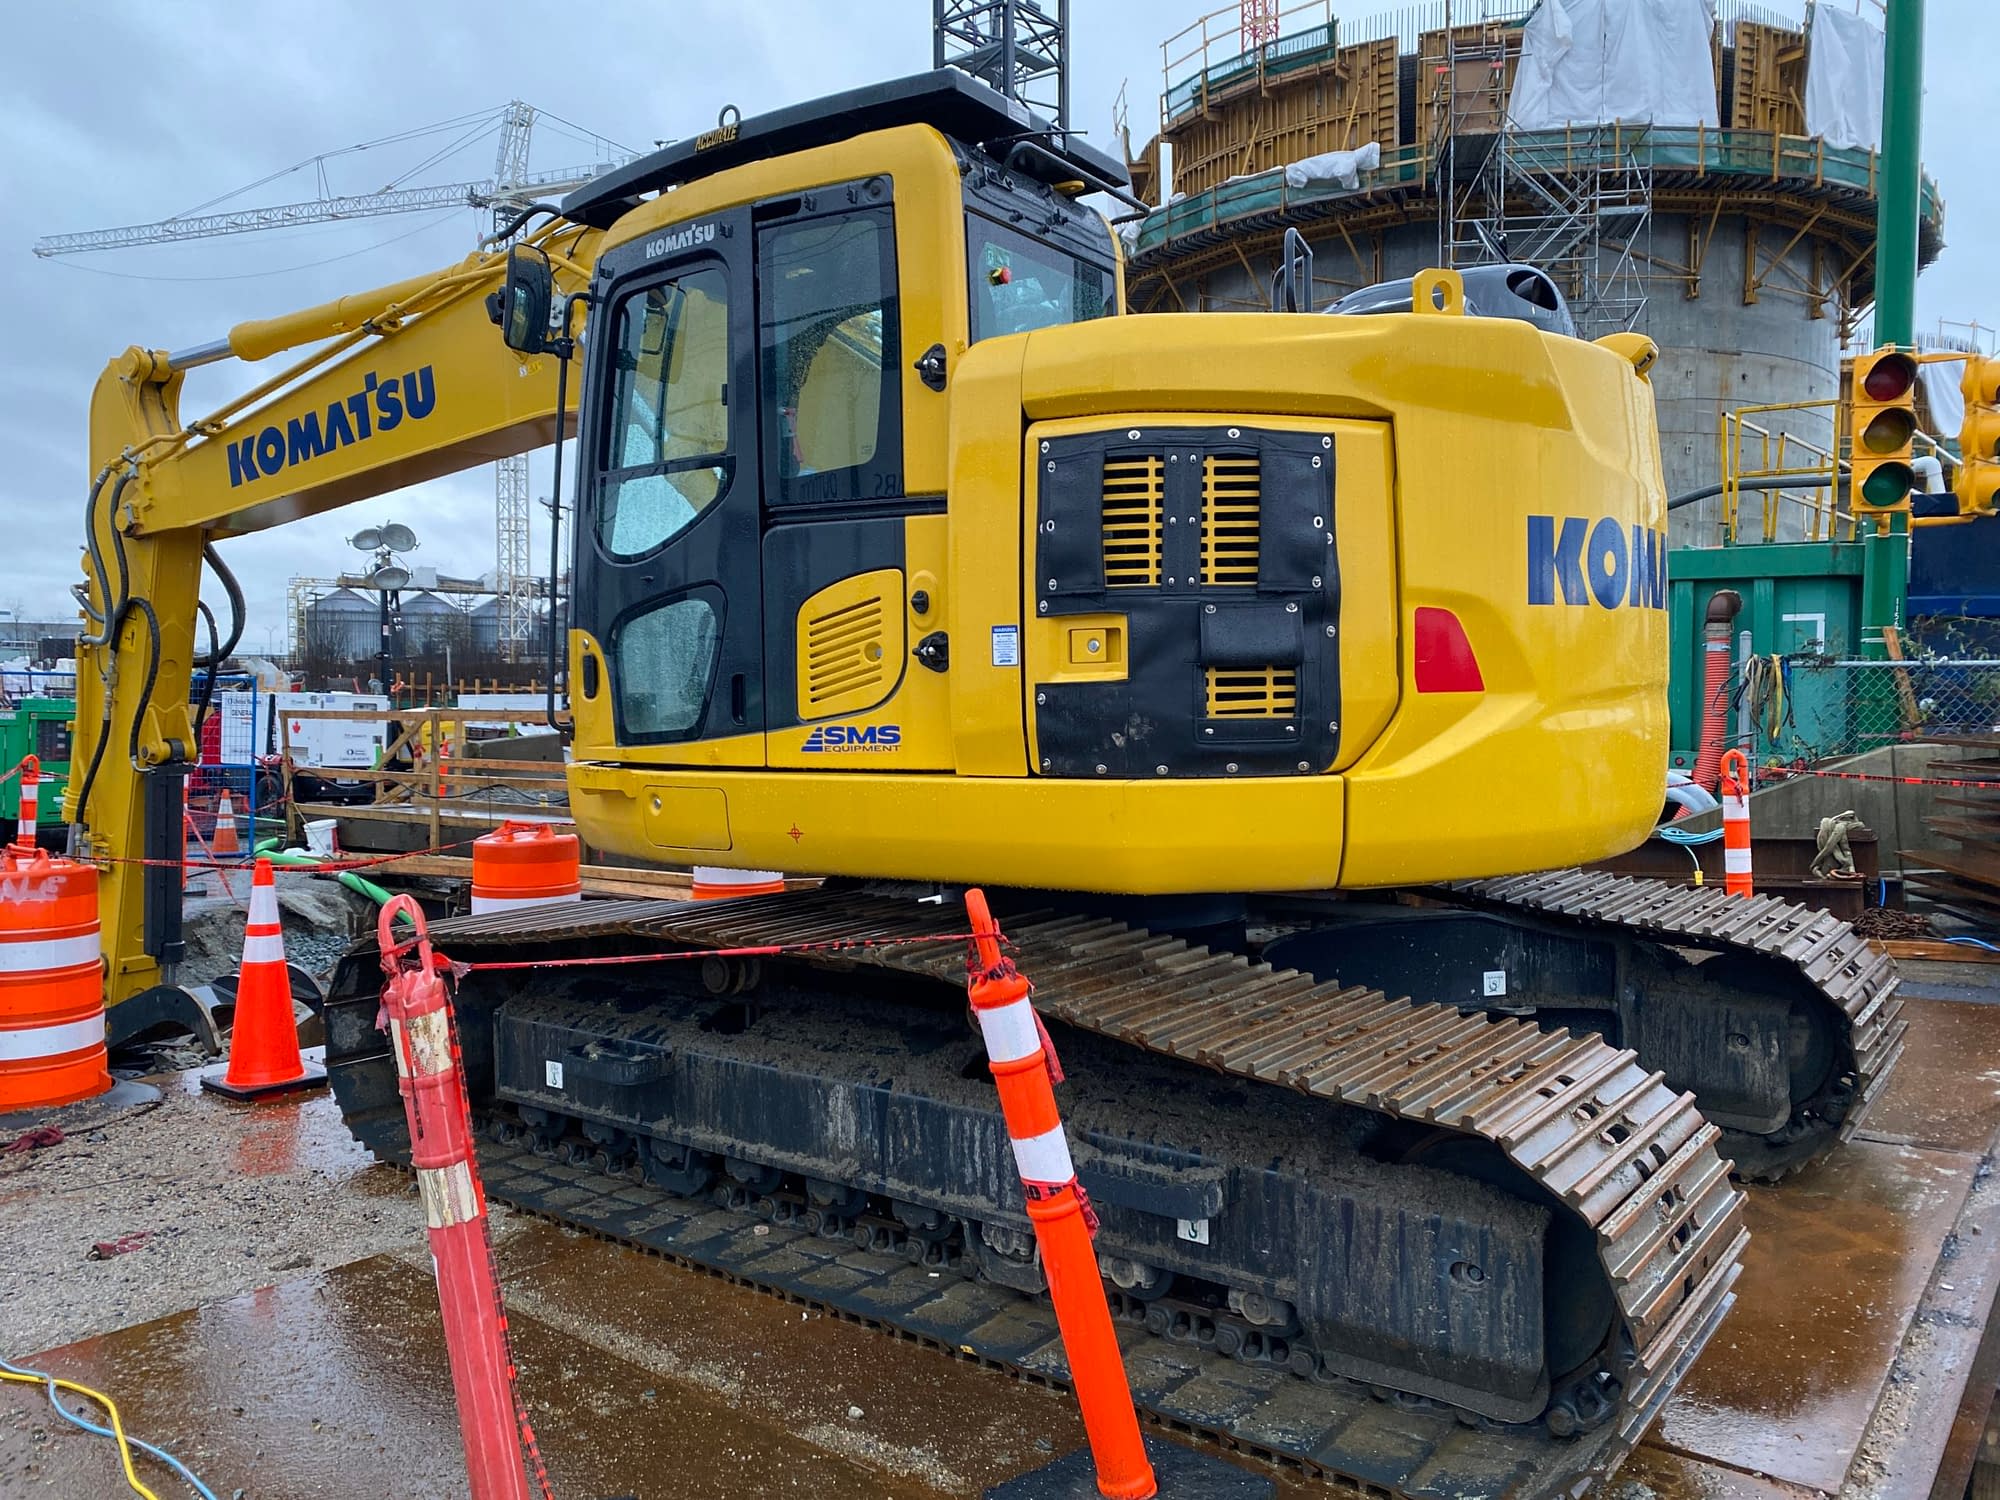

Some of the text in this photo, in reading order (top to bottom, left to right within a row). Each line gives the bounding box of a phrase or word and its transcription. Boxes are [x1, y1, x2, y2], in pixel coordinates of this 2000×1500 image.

[646, 223, 715, 259] KOMATSU
[226, 364, 436, 488] KOMATSU
[823, 725, 902, 745] SMS
[824, 744, 902, 753] EQUIPMENT
